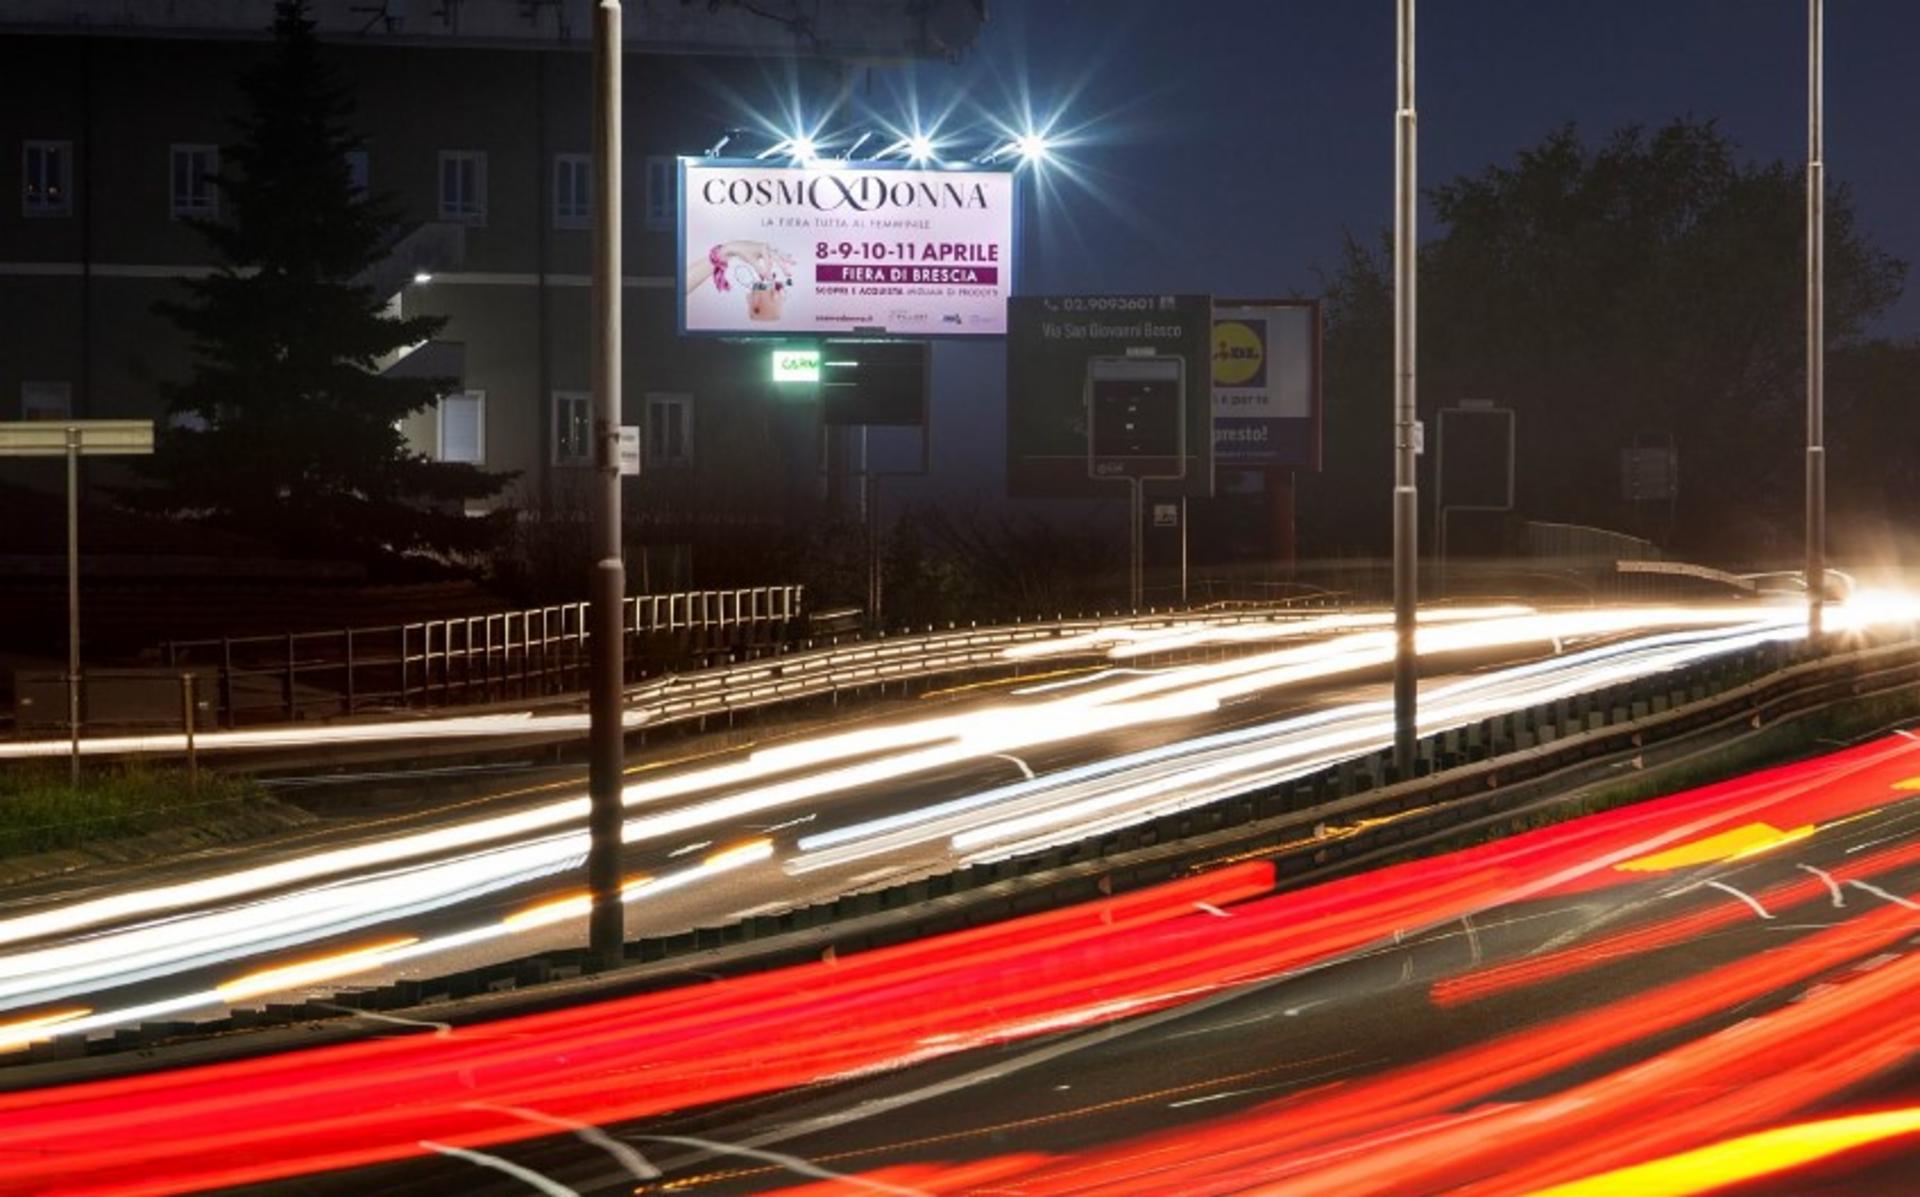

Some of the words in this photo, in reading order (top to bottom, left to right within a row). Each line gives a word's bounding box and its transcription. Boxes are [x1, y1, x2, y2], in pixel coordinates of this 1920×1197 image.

[779, 217, 810, 228] FIERA
[815, 218, 848, 229] TUTTA
[815, 241, 916, 261] 8-9-10-11
[921, 243, 999, 263] APRILE
[842, 267, 886, 282] FIERA
[890, 269, 908, 283] DI
[913, 269, 978, 284] BRESCIA
[1064, 322, 1087, 338] San
